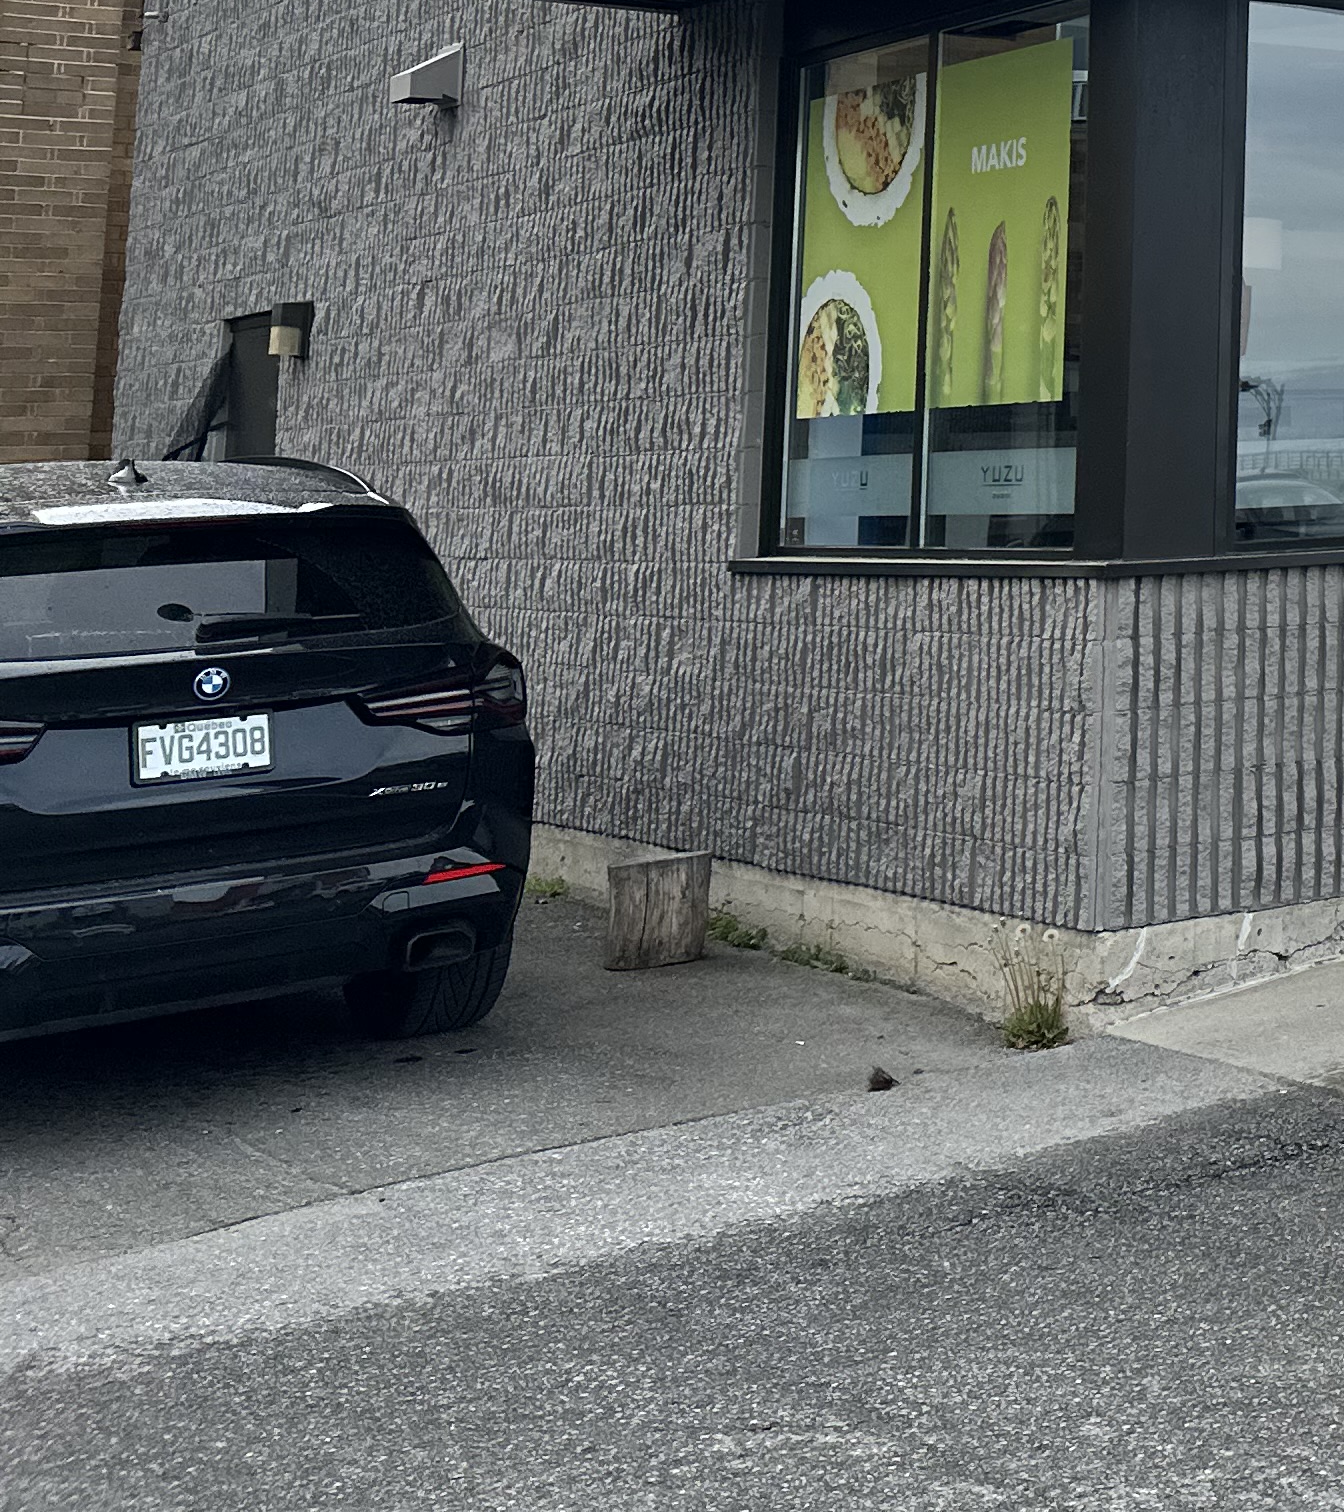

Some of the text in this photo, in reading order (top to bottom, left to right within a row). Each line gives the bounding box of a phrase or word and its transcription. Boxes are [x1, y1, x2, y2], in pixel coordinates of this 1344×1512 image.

[971, 137, 1027, 174] MAKIS
[981, 464, 1024, 483] YUZU
[140, 726, 266, 769] FVG4308
